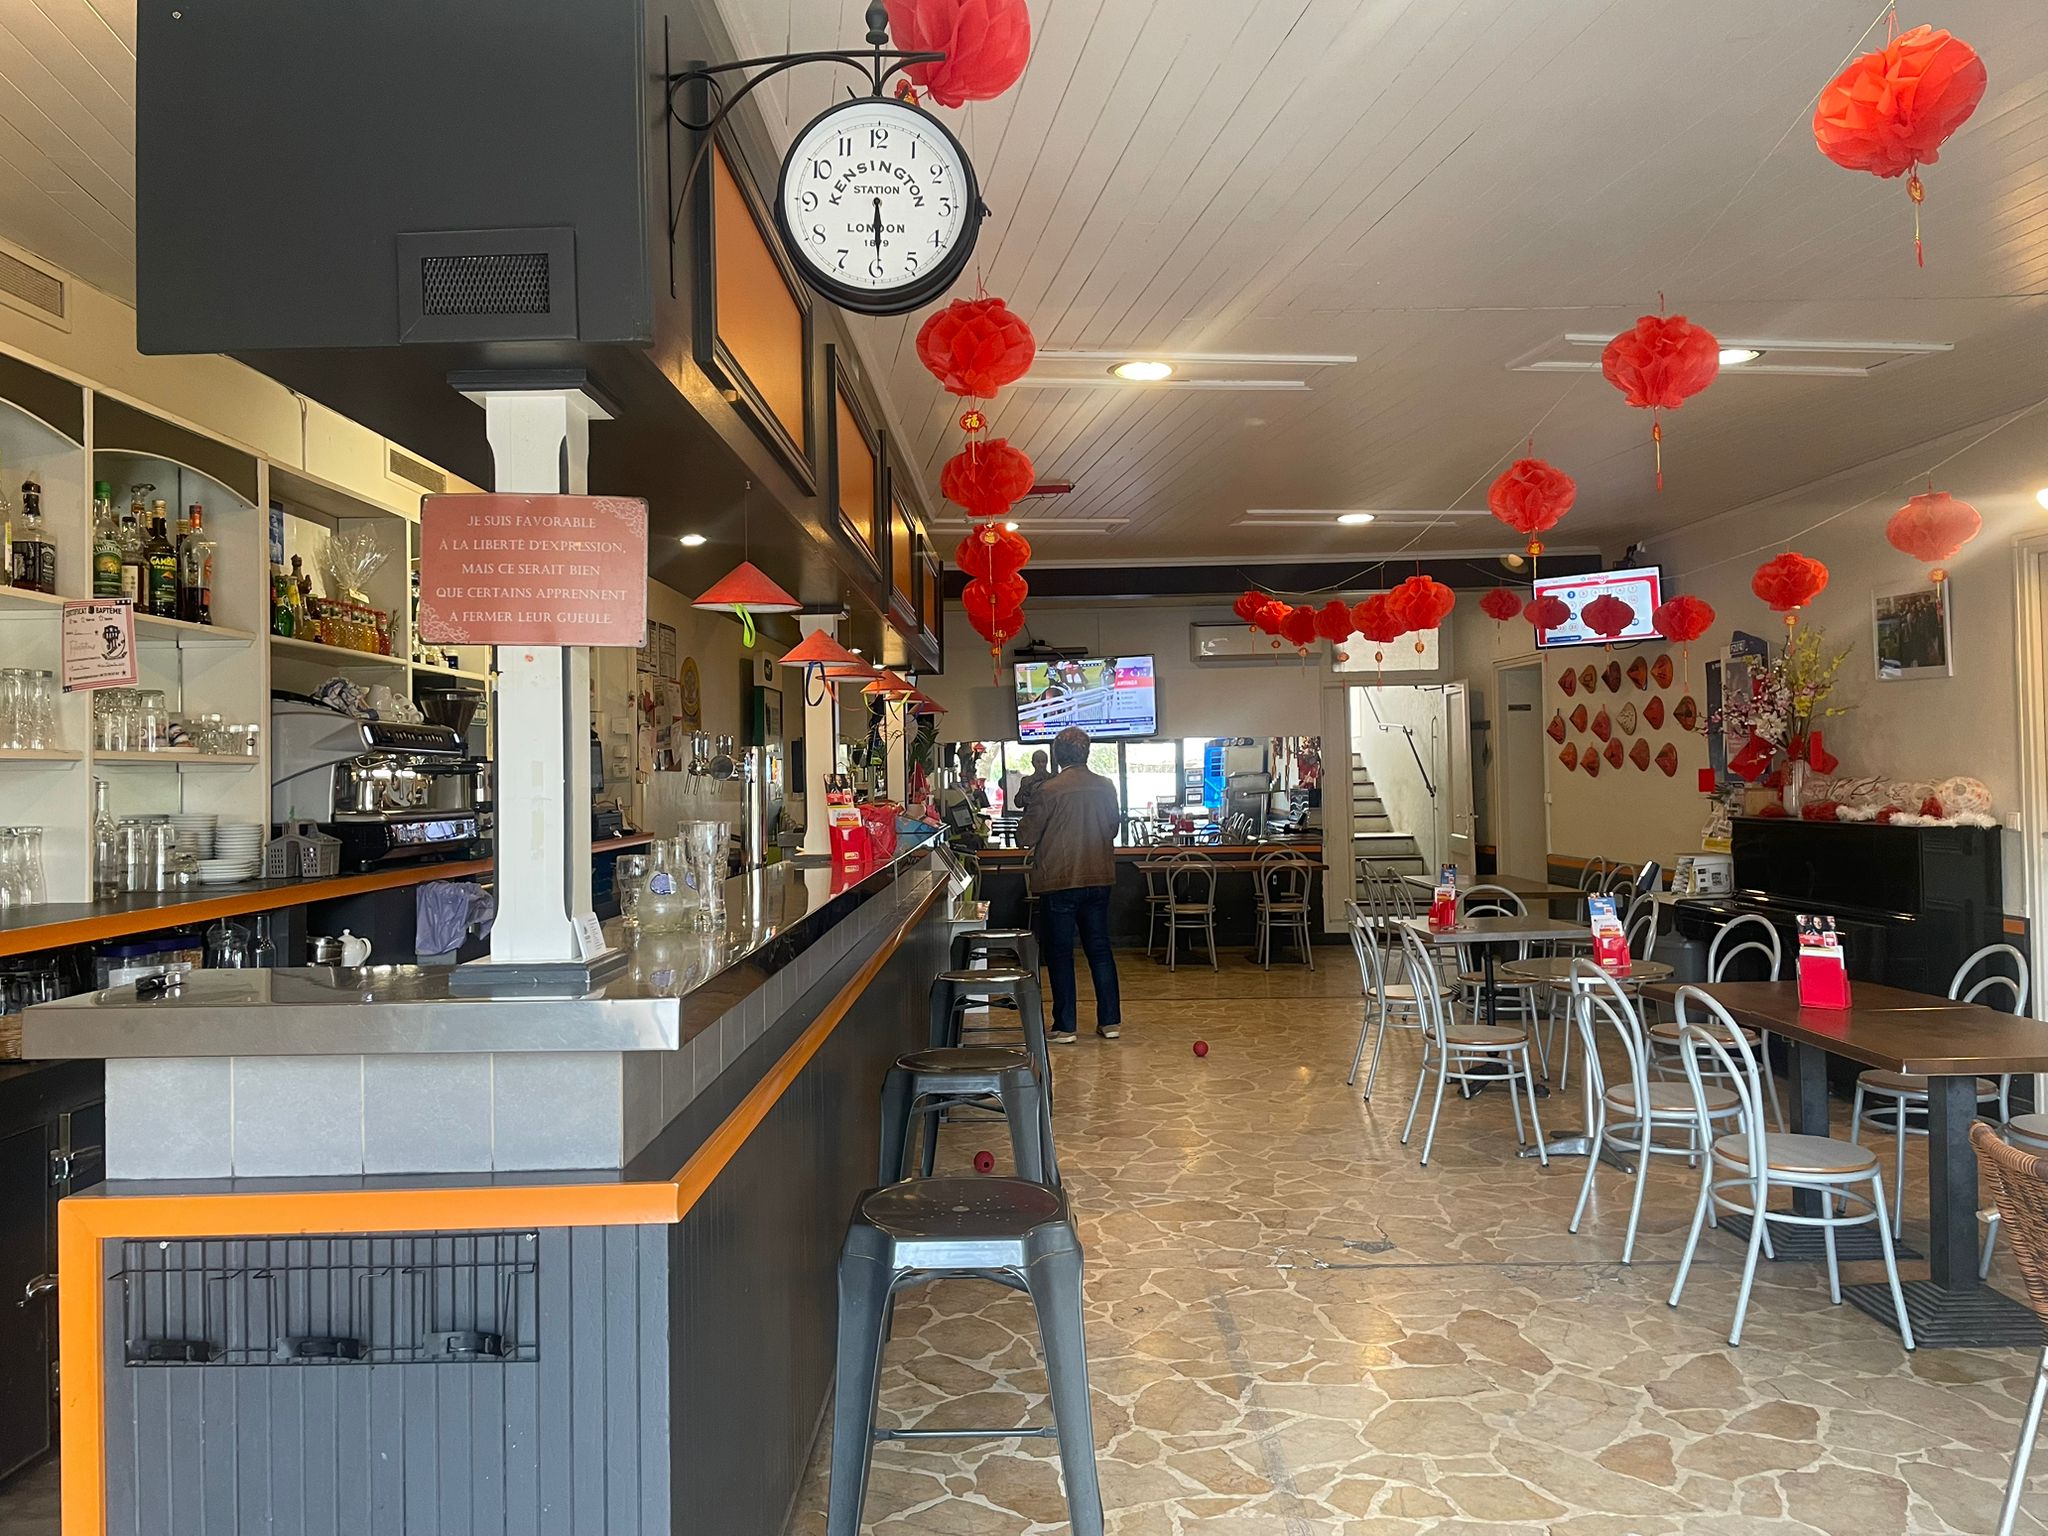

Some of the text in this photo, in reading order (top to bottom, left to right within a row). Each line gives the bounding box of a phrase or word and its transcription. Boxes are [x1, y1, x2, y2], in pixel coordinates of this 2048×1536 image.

[839, 137, 852, 157] 11
[870, 128, 889, 148] 12
[910, 141, 916, 159] 1
[814, 160, 832, 179] 10
[930, 164, 943, 184] 2
[829, 161, 925, 208] KENSINGTON
[853, 185, 900, 194] STATION
[802, 191, 818, 212] 9
[938, 197, 951, 217] 3
[812, 224, 826, 244] 8
[847, 224, 905, 233] LONDON
[927, 230, 942, 248] 4
[837, 249, 848, 269] 7
[869, 258, 883, 278] 6
[905, 252, 918, 272] 5
[965, 414, 980, 428] 福
[467, 515, 596, 529] JE SUIS FAVORABLE
[453, 540, 468, 550] LA
[462, 564, 600, 576] MAIS CE SERAIT BIEN
[436, 587, 627, 601] QUE CERTAINS APPRENNENT
[463, 612, 512, 622] FERMER
[518, 612, 552, 622] LEUR
